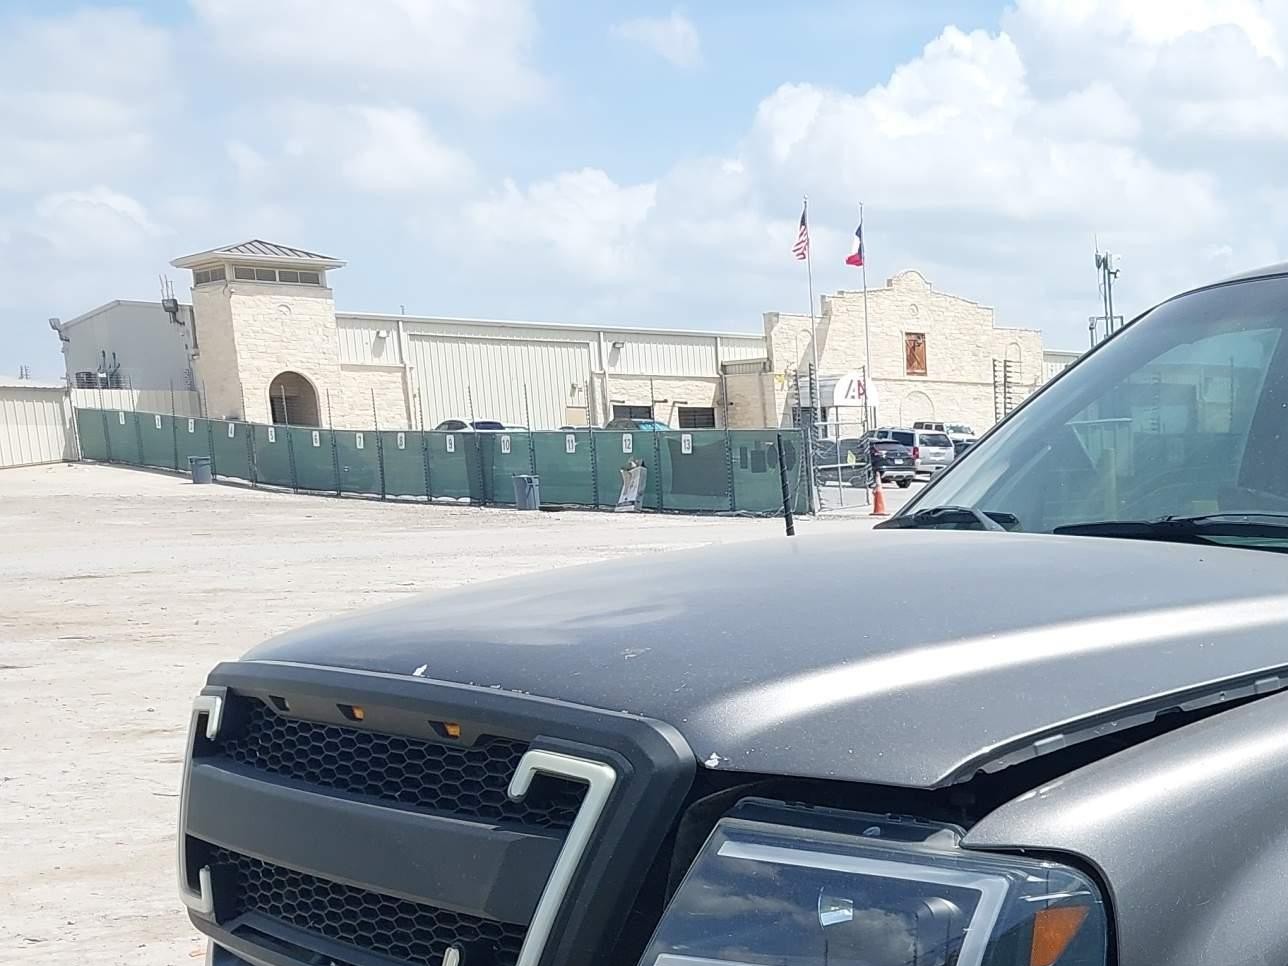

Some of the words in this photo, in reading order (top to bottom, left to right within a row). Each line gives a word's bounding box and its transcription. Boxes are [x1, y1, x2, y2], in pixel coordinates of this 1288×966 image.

[502, 436, 510, 449] 10
[567, 435, 574, 448] 11
[623, 436, 632, 449] 12
[683, 436, 691, 450] 13
